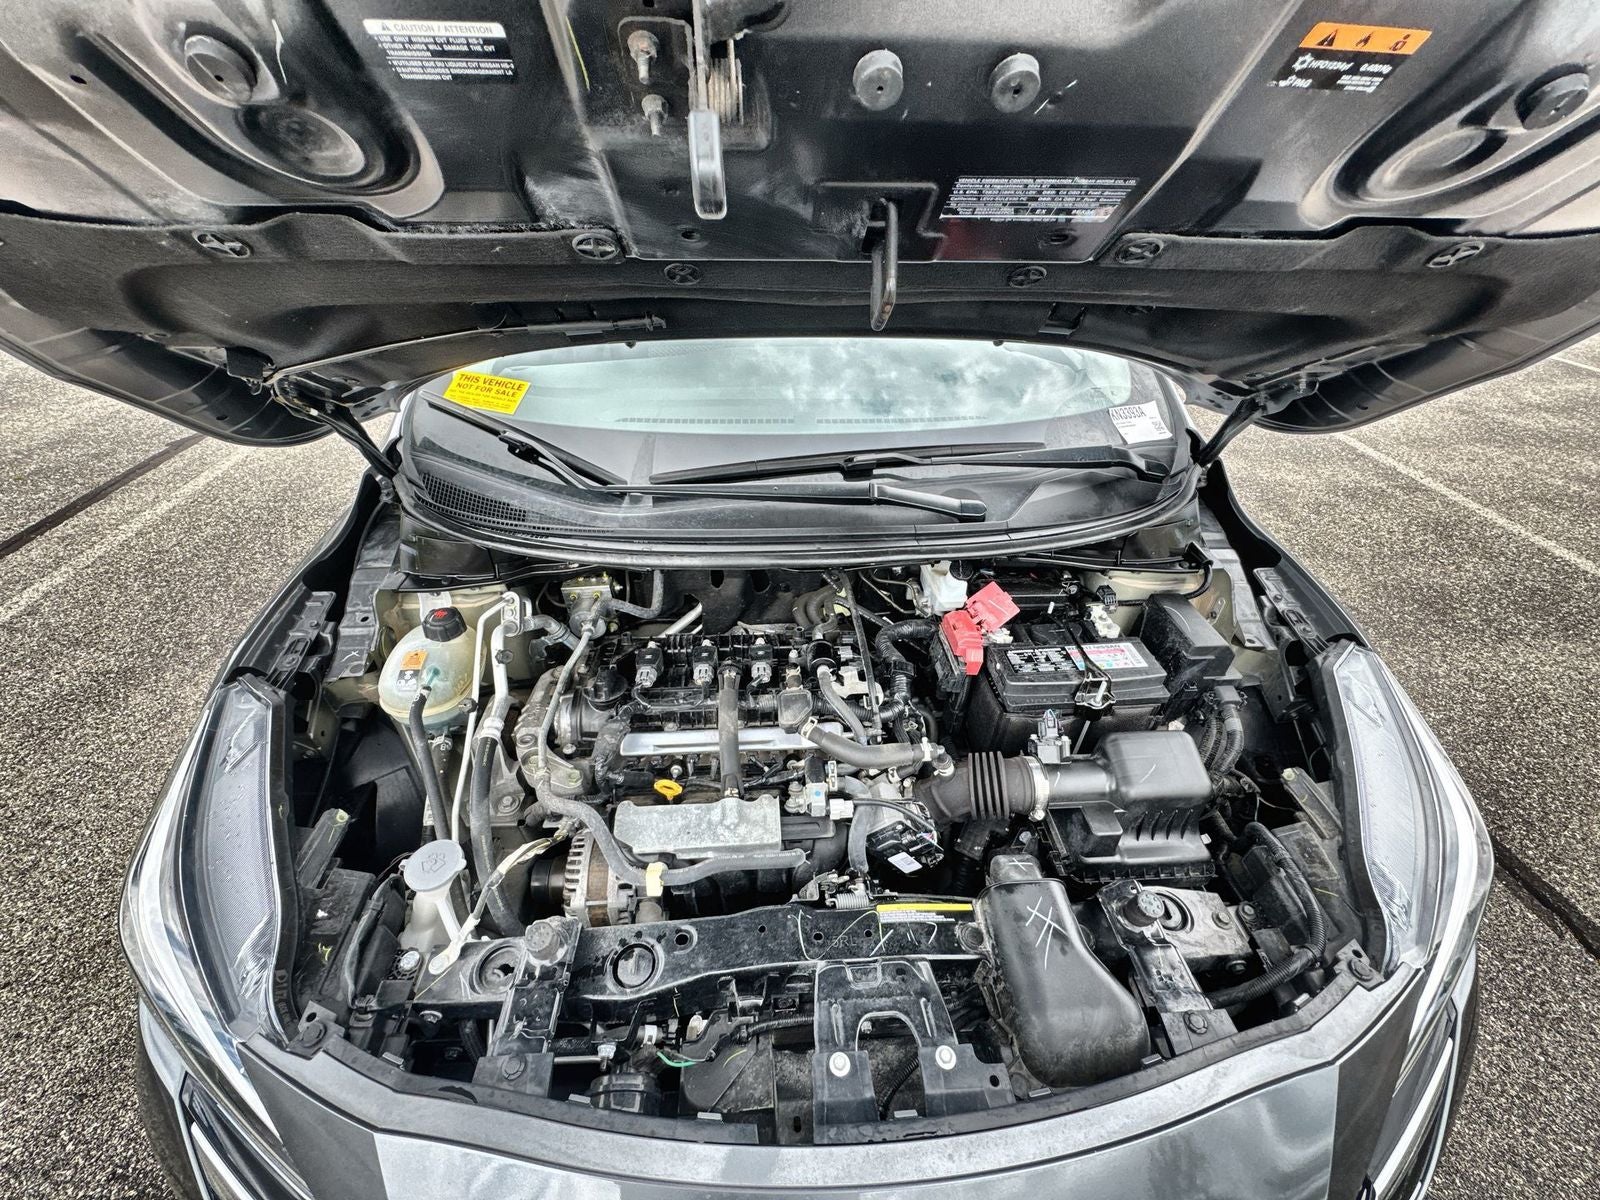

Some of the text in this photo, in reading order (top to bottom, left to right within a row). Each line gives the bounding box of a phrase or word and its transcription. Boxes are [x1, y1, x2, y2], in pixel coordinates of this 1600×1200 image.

[394, 23, 434, 32] CAUTION
[444, 24, 493, 34] ATTENTION
[459, 374, 525, 391] THIS VEHICLE
[494, 390, 518, 398] SALE
